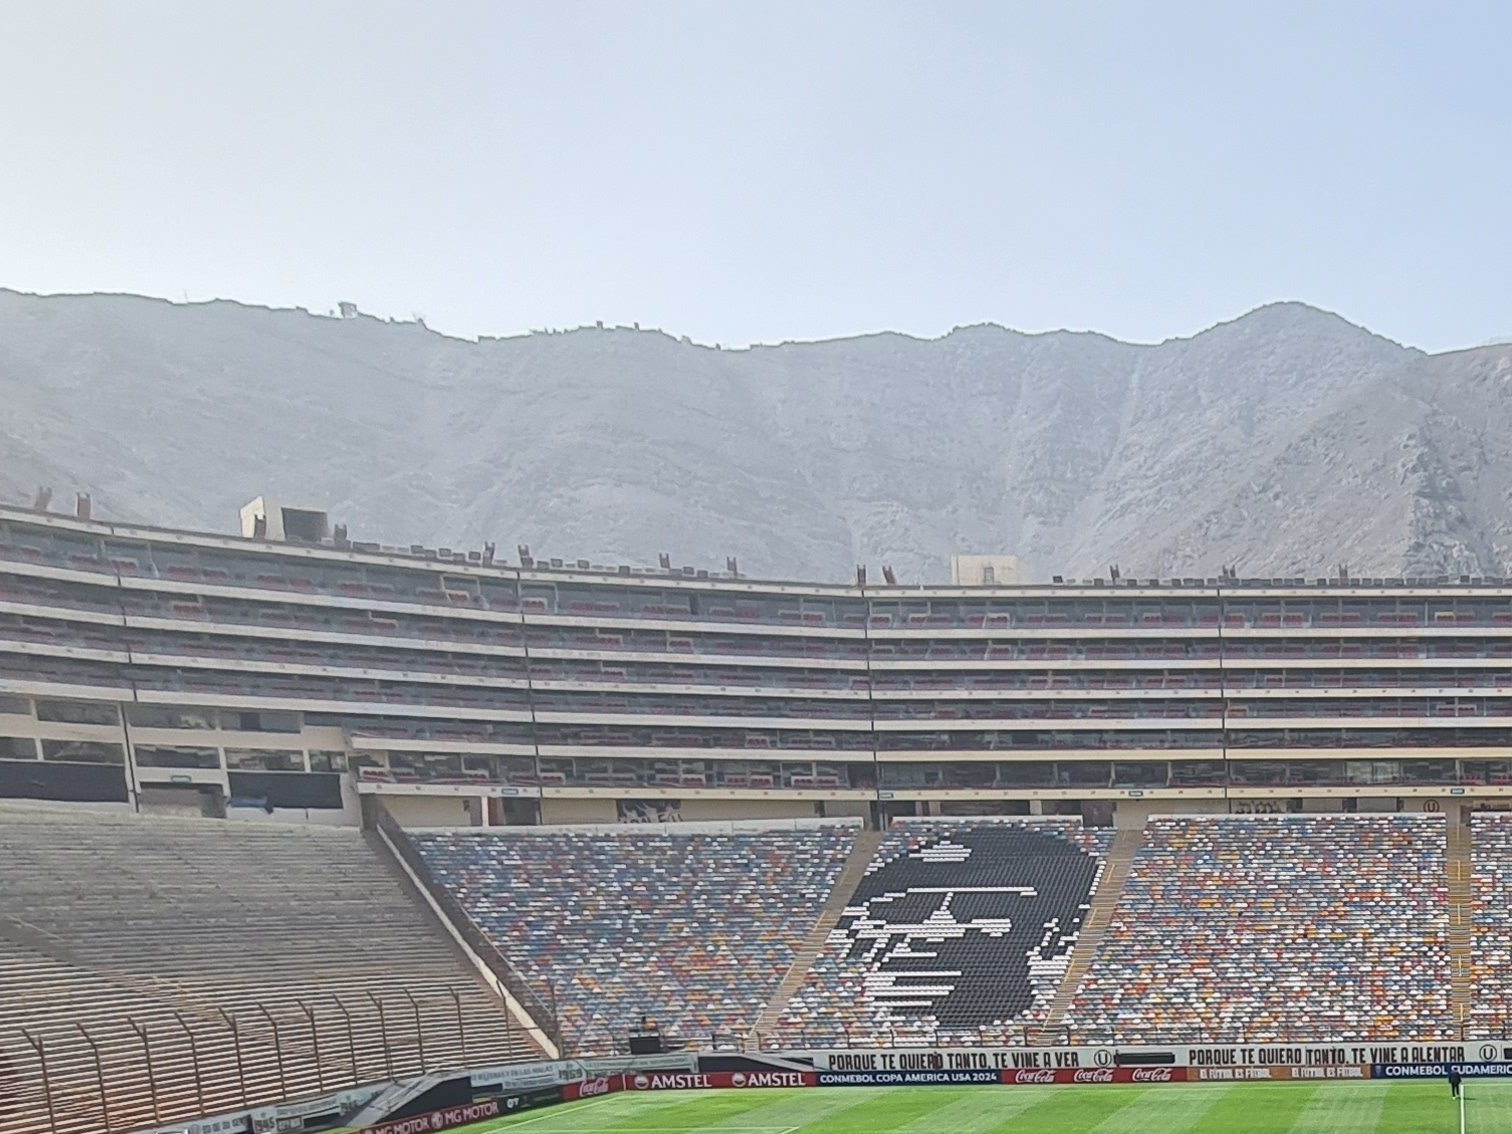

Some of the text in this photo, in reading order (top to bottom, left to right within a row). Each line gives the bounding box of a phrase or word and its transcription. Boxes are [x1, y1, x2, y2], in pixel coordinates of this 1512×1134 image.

[828, 1053, 880, 1071] PORQUE
[882, 1053, 896, 1069] TE
[900, 1052, 943, 1070] QUIERO
[994, 1051, 1008, 1068] TE
[1012, 1051, 1040, 1067] VINE
[1043, 1051, 1051, 1067] A
[1056, 1051, 1079, 1067] VER
[1189, 1048, 1238, 1065] PORQUE
[1241, 1047, 1254, 1064] TE
[1257, 1047, 1302, 1064] QUIERO
[1353, 1046, 1366, 1063] TE
[1371, 1046, 1397, 1062] VINE
[1401, 1046, 1409, 1062] A
[1412, 1046, 1465, 1062] ALENTAR
[819, 1071, 997, 1084] CONMEBOL COPA AMERICA USA 2024
[1015, 1067, 1056, 1083] Coca-Cola
[1073, 1067, 1114, 1082] Coca-Cola
[1131, 1066, 1172, 1081] Coca-Cola
[1386, 1065, 1448, 1076] CONMEBOL
[651, 1074, 712, 1088] AMSTEL
[748, 1073, 806, 1087] AMSTEL
[444, 1109, 462, 1125] MG
[462, 1101, 499, 1120] MOTOR
